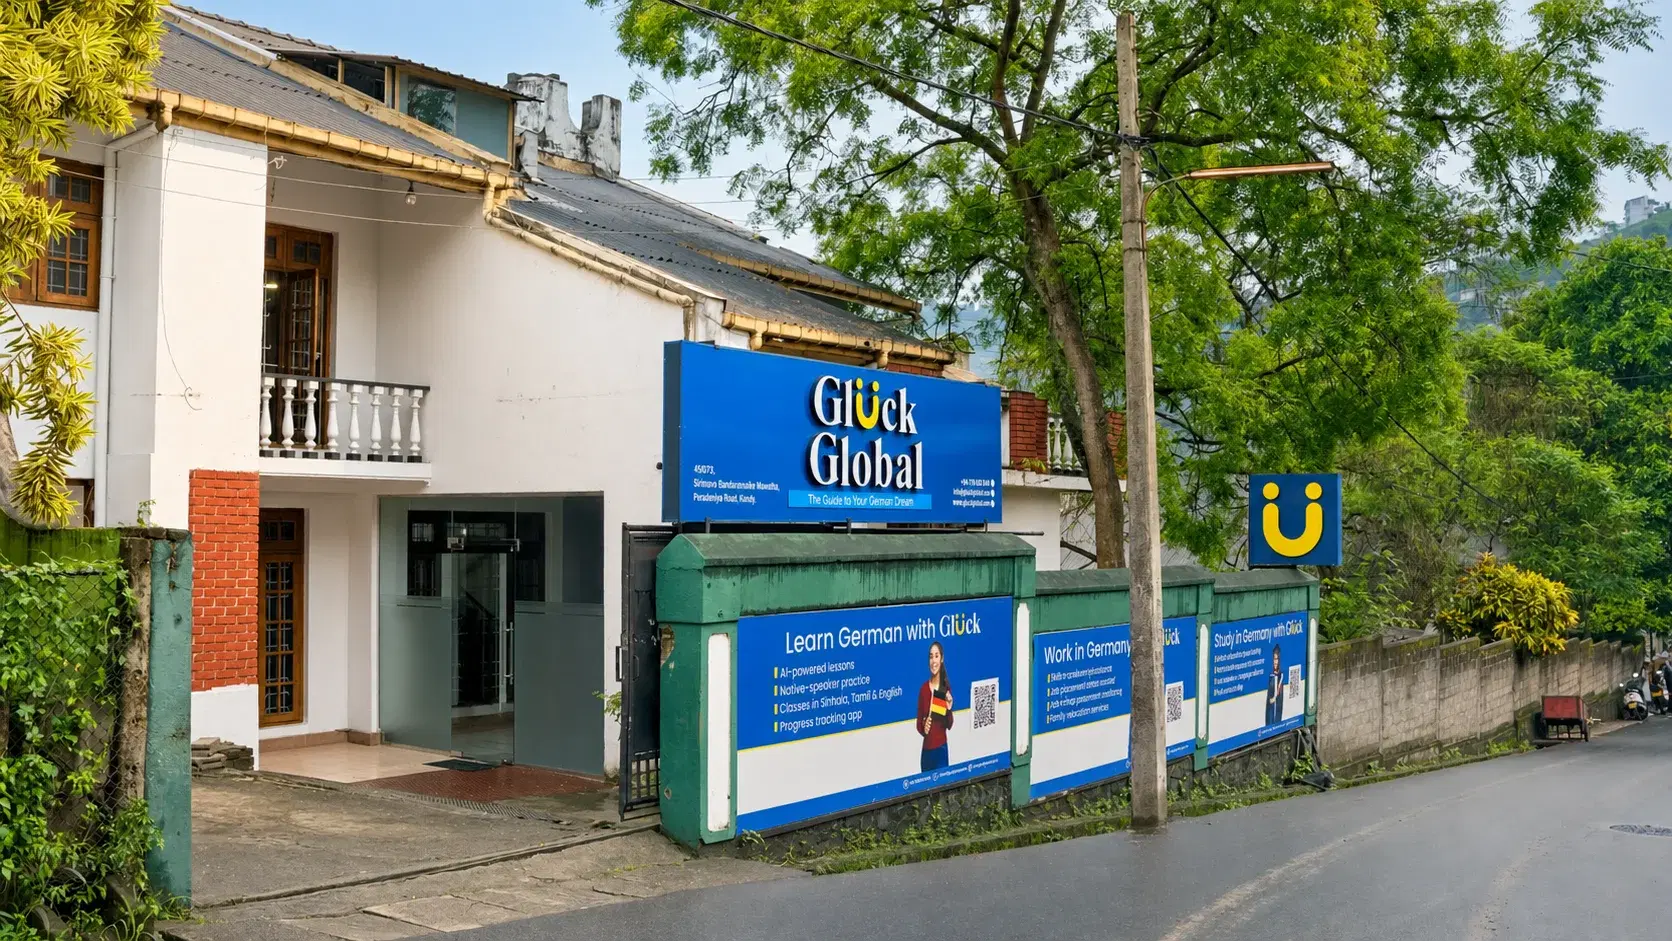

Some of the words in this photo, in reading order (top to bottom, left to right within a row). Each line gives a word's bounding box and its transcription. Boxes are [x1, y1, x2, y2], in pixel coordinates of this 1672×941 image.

[814, 376, 917, 434] Glück
[810, 432, 923, 489] Global
[808, 494, 821, 504] The
[823, 495, 842, 505] Guide
[844, 496, 851, 505] to
[853, 495, 867, 506] Your
[869, 496, 893, 506] German
[895, 496, 914, 506] Dream
[786, 631, 833, 655] Learn
[839, 626, 902, 649] German
[906, 618, 935, 640] with
[940, 612, 981, 637] Glück
[1215, 630, 1235, 649] Study
[1236, 629, 1242, 644] in
[1243, 628, 1272, 643] Germany
[1273, 623, 1285, 637] with
[1043, 644, 1073, 664] Work
[1075, 641, 1084, 661] in
[1087, 640, 1130, 658] Germany
[780, 663, 826, 679] AI-powered
[828, 660, 855, 673] lessons
[780, 678, 839, 696] Native-speaker
[841, 675, 870, 690] practice
[780, 701, 810, 714] Classes
[811, 699, 819, 709] in
[821, 695, 849, 708] Sinhala,
[851, 690, 871, 703] Tamil
[872, 690, 877, 700] &
[879, 686, 903, 701] English
[780, 718, 813, 733] Progress
[815, 712, 846, 726] tracking
[848, 709, 862, 723] app
